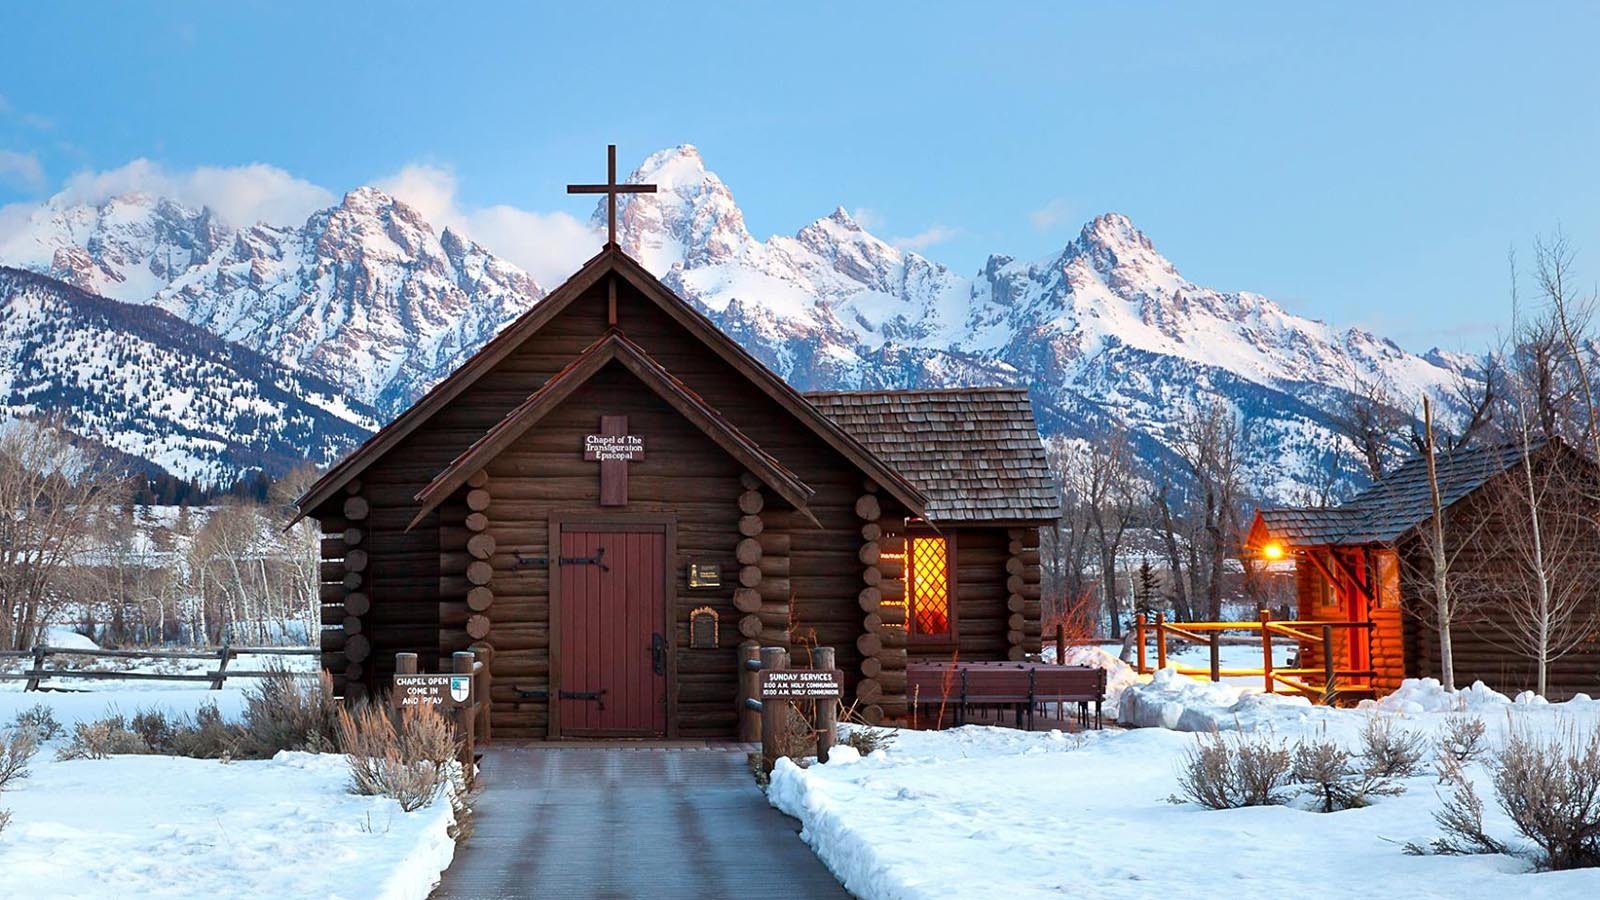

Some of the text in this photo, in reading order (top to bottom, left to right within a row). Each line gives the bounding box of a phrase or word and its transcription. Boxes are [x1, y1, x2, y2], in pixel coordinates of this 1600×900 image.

[587, 435, 642, 445] Chapel of The
[586, 444, 643, 453] Transfiguration
[596, 451, 633, 461] Episcopal
[396, 677, 449, 686] CHAPEL OPEN
[769, 673, 833, 681] SUNDAY SERVICES
[407, 687, 428, 695] COME
[402, 697, 419, 705] AND
